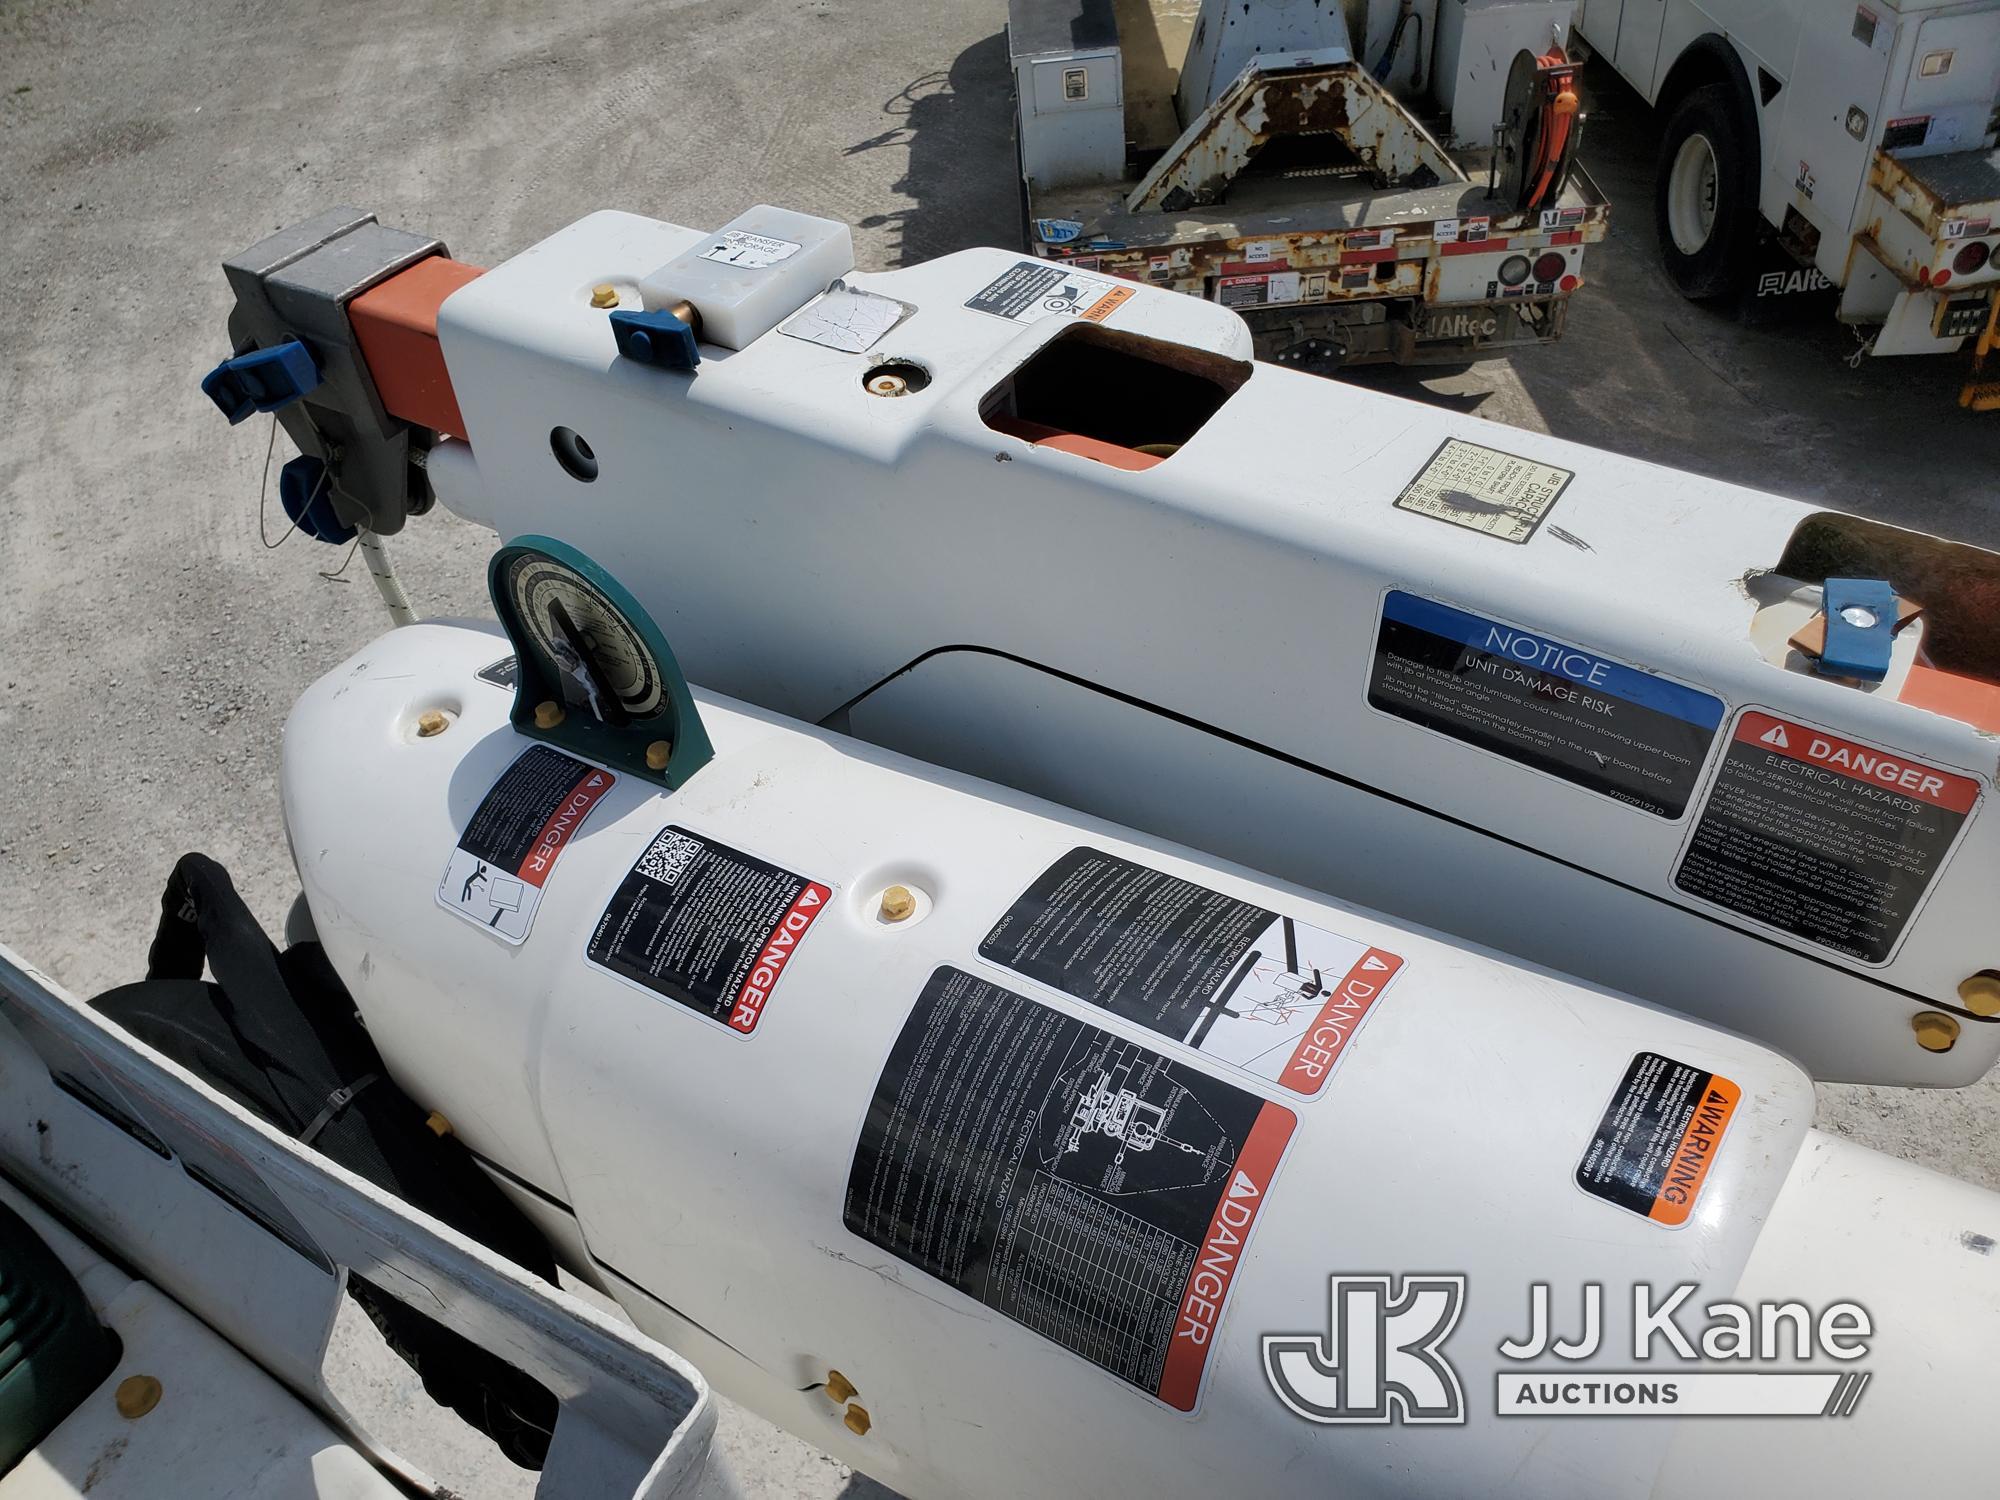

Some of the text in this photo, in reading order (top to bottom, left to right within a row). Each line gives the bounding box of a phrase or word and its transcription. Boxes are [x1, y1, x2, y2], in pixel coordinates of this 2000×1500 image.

[1784, 268, 1831, 294] Alte
[1439, 314, 1497, 337] Altec
[1403, 493, 1416, 503] LBS
[1414, 496, 1428, 507] LBS
[1484, 625, 1611, 687] NOTICE
[1385, 659, 1493, 705] with jib at improper angle.
[1464, 654, 1615, 717] UNIT DAMAGE RISK
[1386, 651, 1691, 766] Damage to the jib and turntable could result from stowing upper boom
[1383, 673, 1672, 785] Jib must be "tilted" approximately parallel to the upper boom before
[1764, 754, 1921, 814] ELECTRICAL HAZARDS
[1807, 738, 1946, 798] DANGER
[530, 790, 568, 836] FALL HAZARD
[1608, 789, 1664, 815] 970229192 D
[1723, 766, 1898, 831] to follow safe electrical work practices.
[1726, 758, 1755, 772] DEATH
[1766, 772, 1803, 789] SERIOUS
[1804, 784, 1836, 800] INJURY
[1838, 796, 1853, 806] will
[1854, 801, 1880, 815] result
[1881, 811, 1904, 823] from
[1905, 819, 1935, 834] failure
[529, 793, 589, 872] DANGER
[782, 876, 797, 892] Death
[738, 874, 790, 944] unit without proper training.
[753, 916, 767, 932] injury
[764, 897, 780, 916] serious
[591, 913, 612, 950] 067040172
[722, 884, 801, 1007] UNTRAINED OPERATOR HAZARD
[748, 931, 757, 942] will
[986, 915, 1014, 944] 067040252
[731, 958, 742, 973] from
[738, 942, 751, 958] result
[1199, 936, 1250, 995] ELECTRICAL HAZARD
[733, 911, 805, 1028] DANGER
[716, 972, 734, 1003] operating
[712, 1003, 721, 1014] this
[1294, 981, 1375, 1079] DANGER
[1672, 1065, 1683, 1078] death
[1680, 1068, 1690, 1080] hoses
[1653, 1097, 1667, 1113] injury.
[1662, 1082, 1673, 1098] serious
[1665, 1084, 1683, 1106] insulating
[1638, 1071, 1699, 1189] Replacing non-conductive hoses with conductive
[1657, 1105, 1671, 1126] sections
[1645, 1141, 1655, 1153] unit
[1650, 1132, 1660, 1142] this
[1660, 1104, 1694, 1168] ELECTRICAL HAZARD
[994, 1109, 1035, 1209] ELECTRICAL HAZARD
[1201, 1144, 1215, 1168] DISTANCE
[1201, 1135, 1226, 1183] MINIMUM APPROACH
[1638, 1152, 1650, 1169] could
[1663, 1105, 1725, 1205] WARNING
[1629, 1168, 1641, 1187] cause
[1023, 1184, 1039, 1216] WORKERS
[1029, 1182, 1047, 1224] UNQUALIFIED
[995, 1196, 1025, 1291] Minimum Approach Distance
[1160, 1250, 1176, 1284] KILOVOLTS
[1164, 1243, 1187, 1298] PHASE-TO-PHASE
[1171, 1247, 1193, 1301] VOLTAGE RATING
[1178, 1198, 1260, 1346] DANGER
